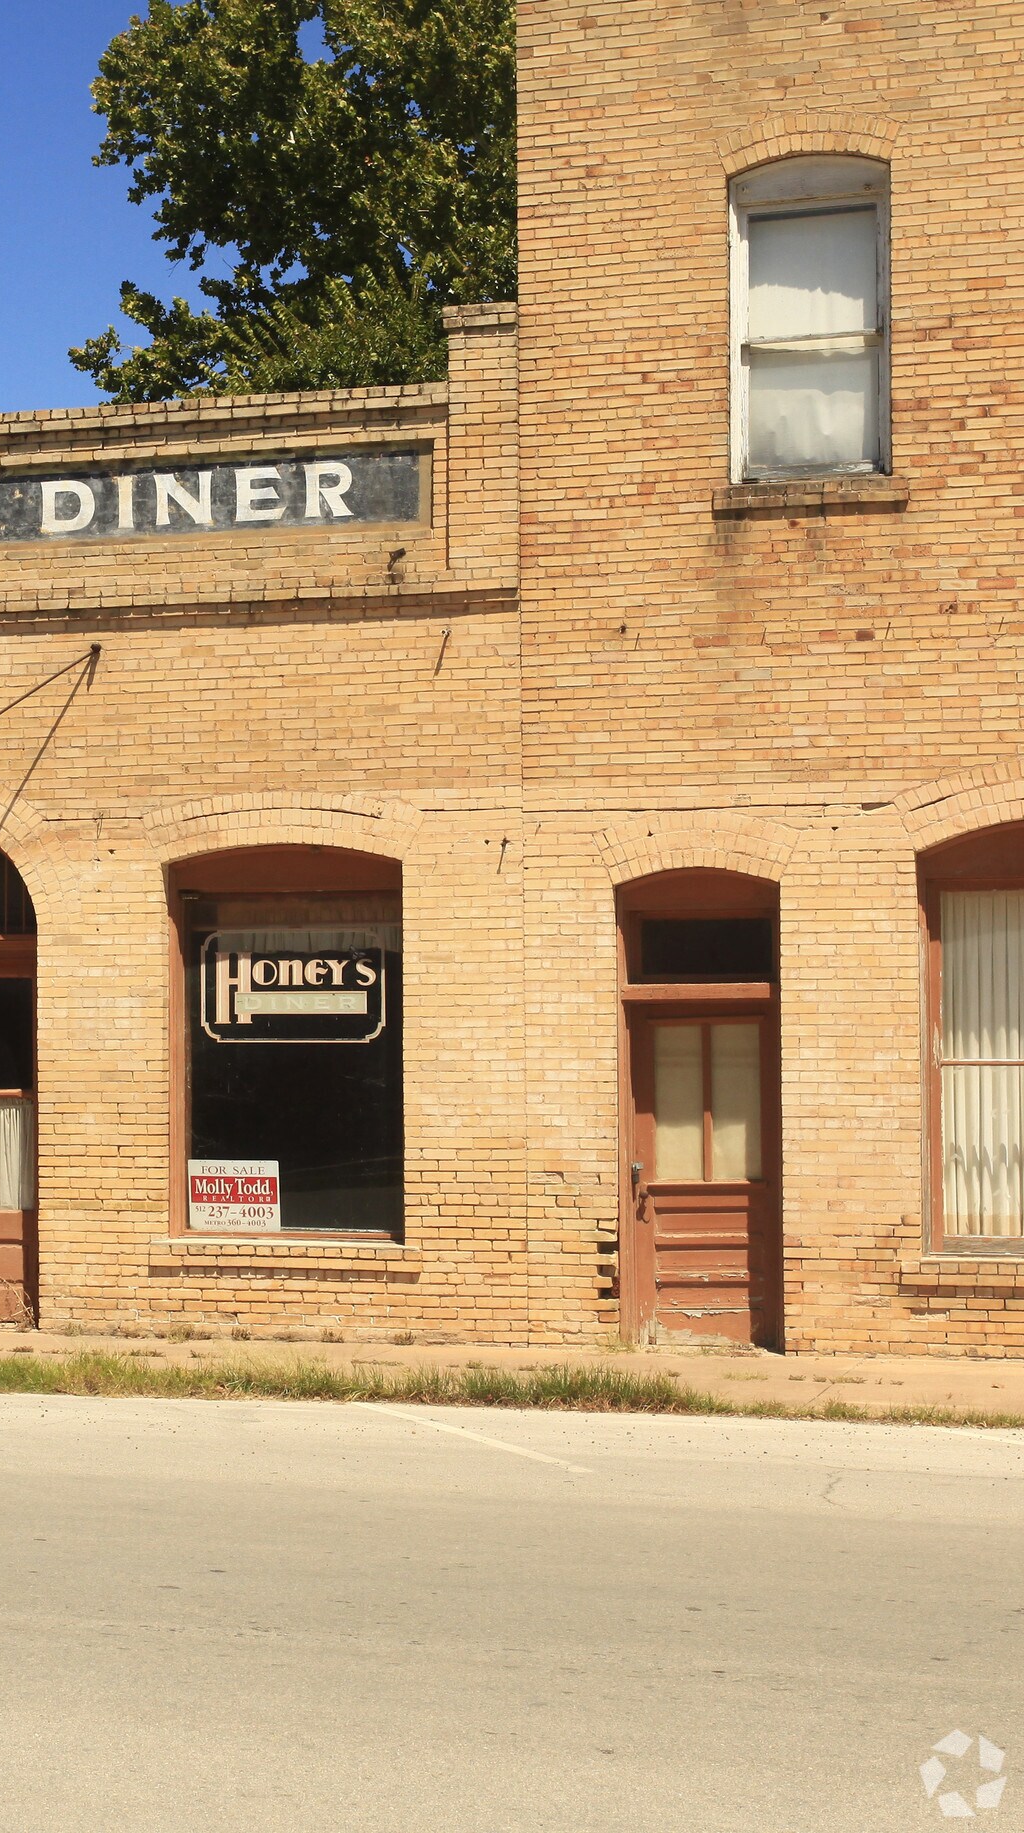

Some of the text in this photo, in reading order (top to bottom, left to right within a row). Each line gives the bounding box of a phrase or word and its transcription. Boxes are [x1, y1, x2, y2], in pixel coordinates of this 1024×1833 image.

[40, 461, 355, 534] DINER
[244, 996, 358, 1010] DINER
[201, 1166, 266, 1175] FOR SALE
[195, 1178, 274, 1198] Molly Todd,
[208, 1205, 274, 1219] 237-4003
